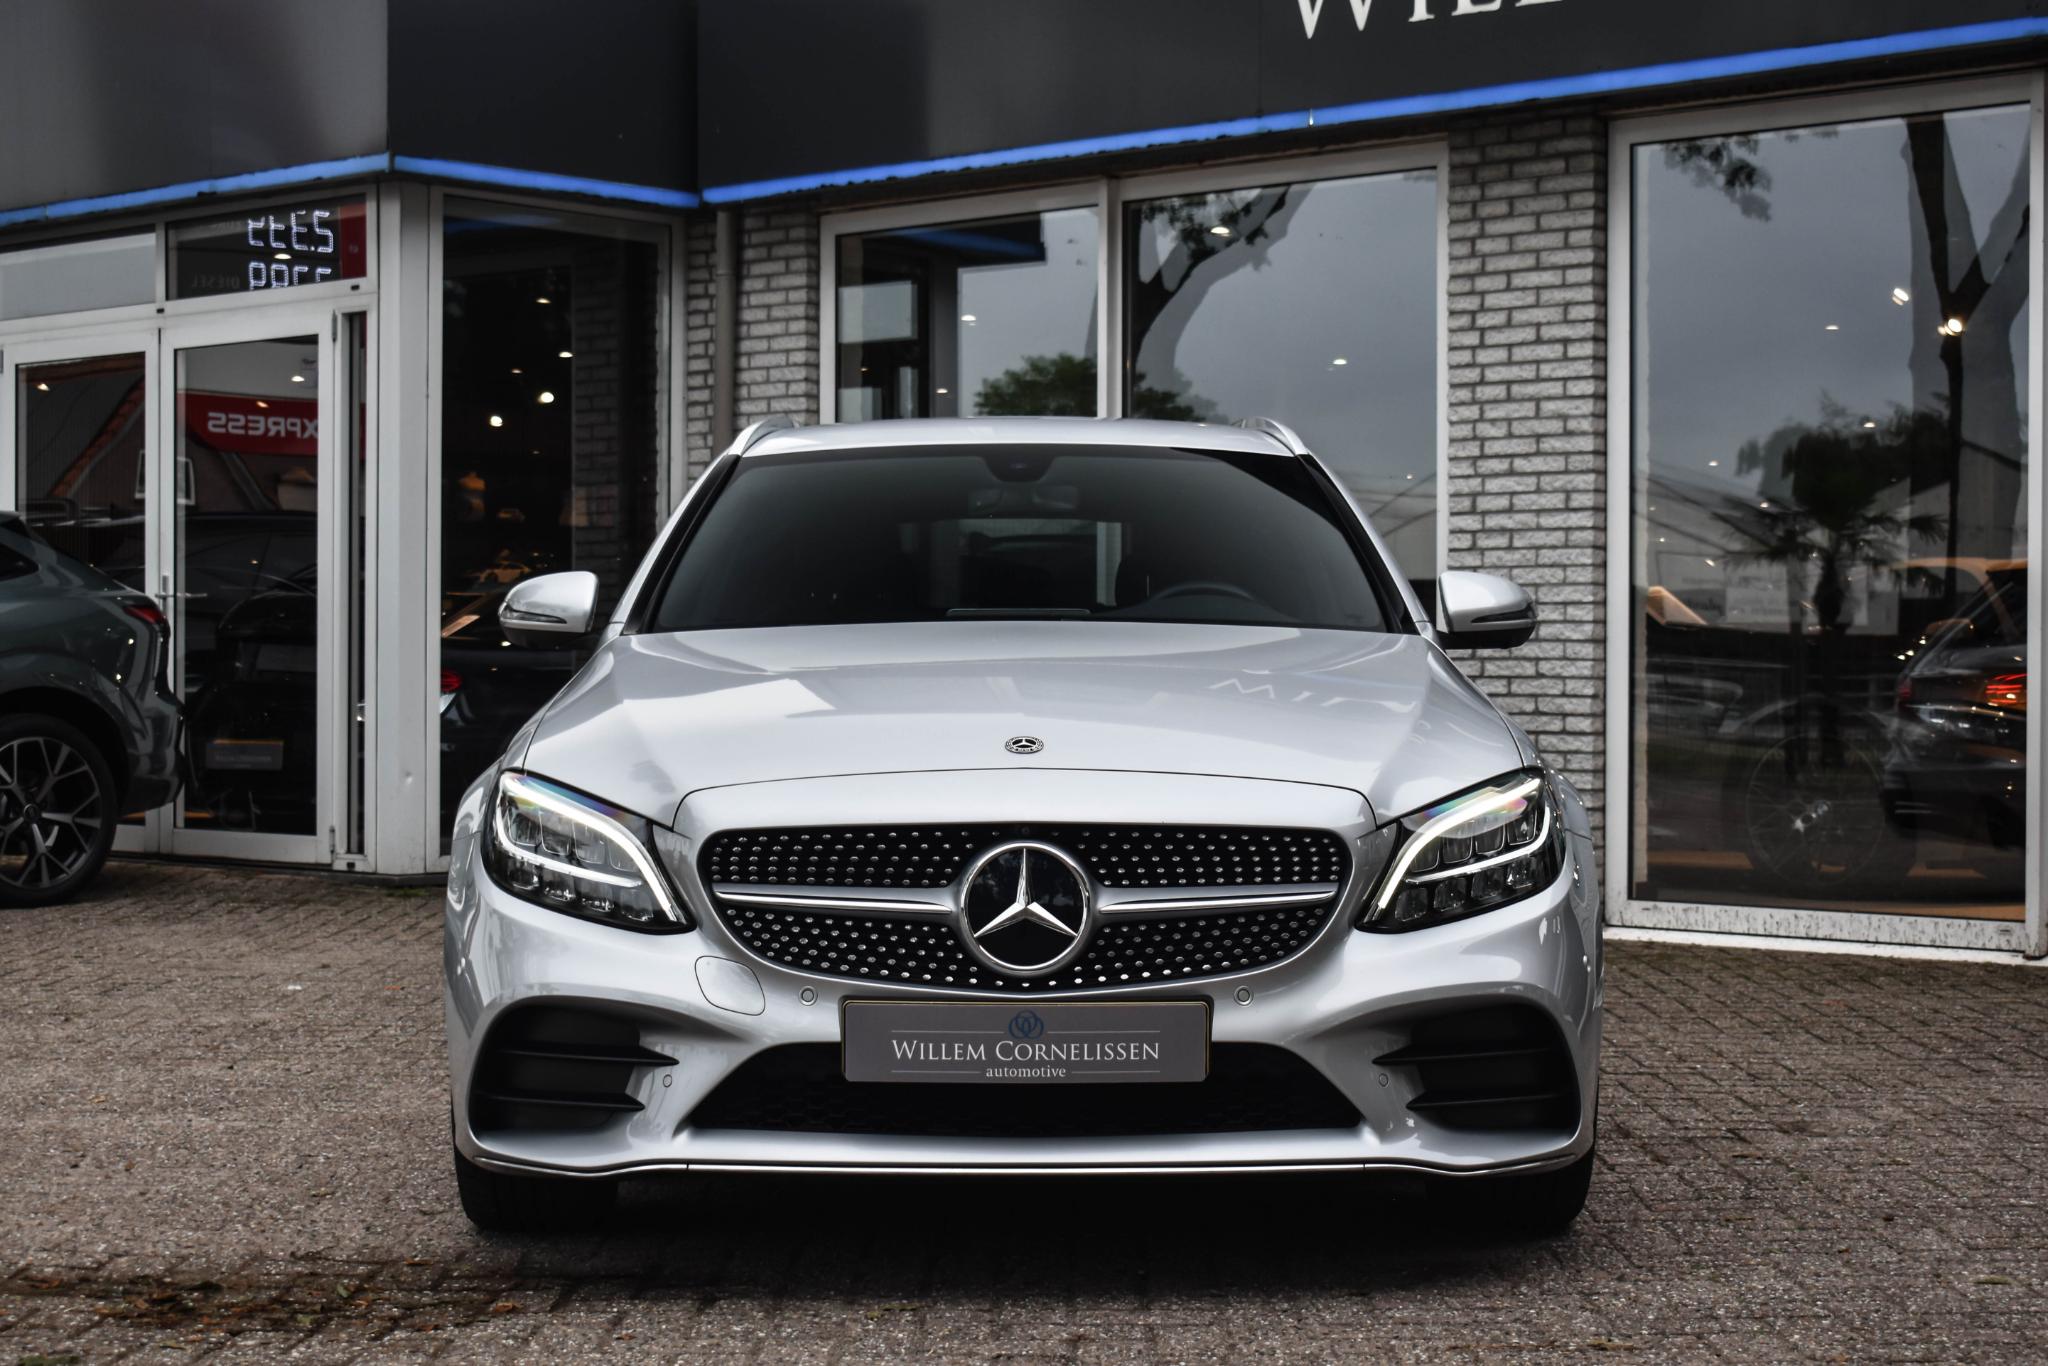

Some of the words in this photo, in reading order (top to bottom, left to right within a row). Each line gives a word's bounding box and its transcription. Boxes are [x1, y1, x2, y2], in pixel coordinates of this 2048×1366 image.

[892, 1039, 987, 1061] WILLEM
[995, 1040, 1160, 1062] CORNELISSEN
[986, 1065, 1067, 1078] automotive
